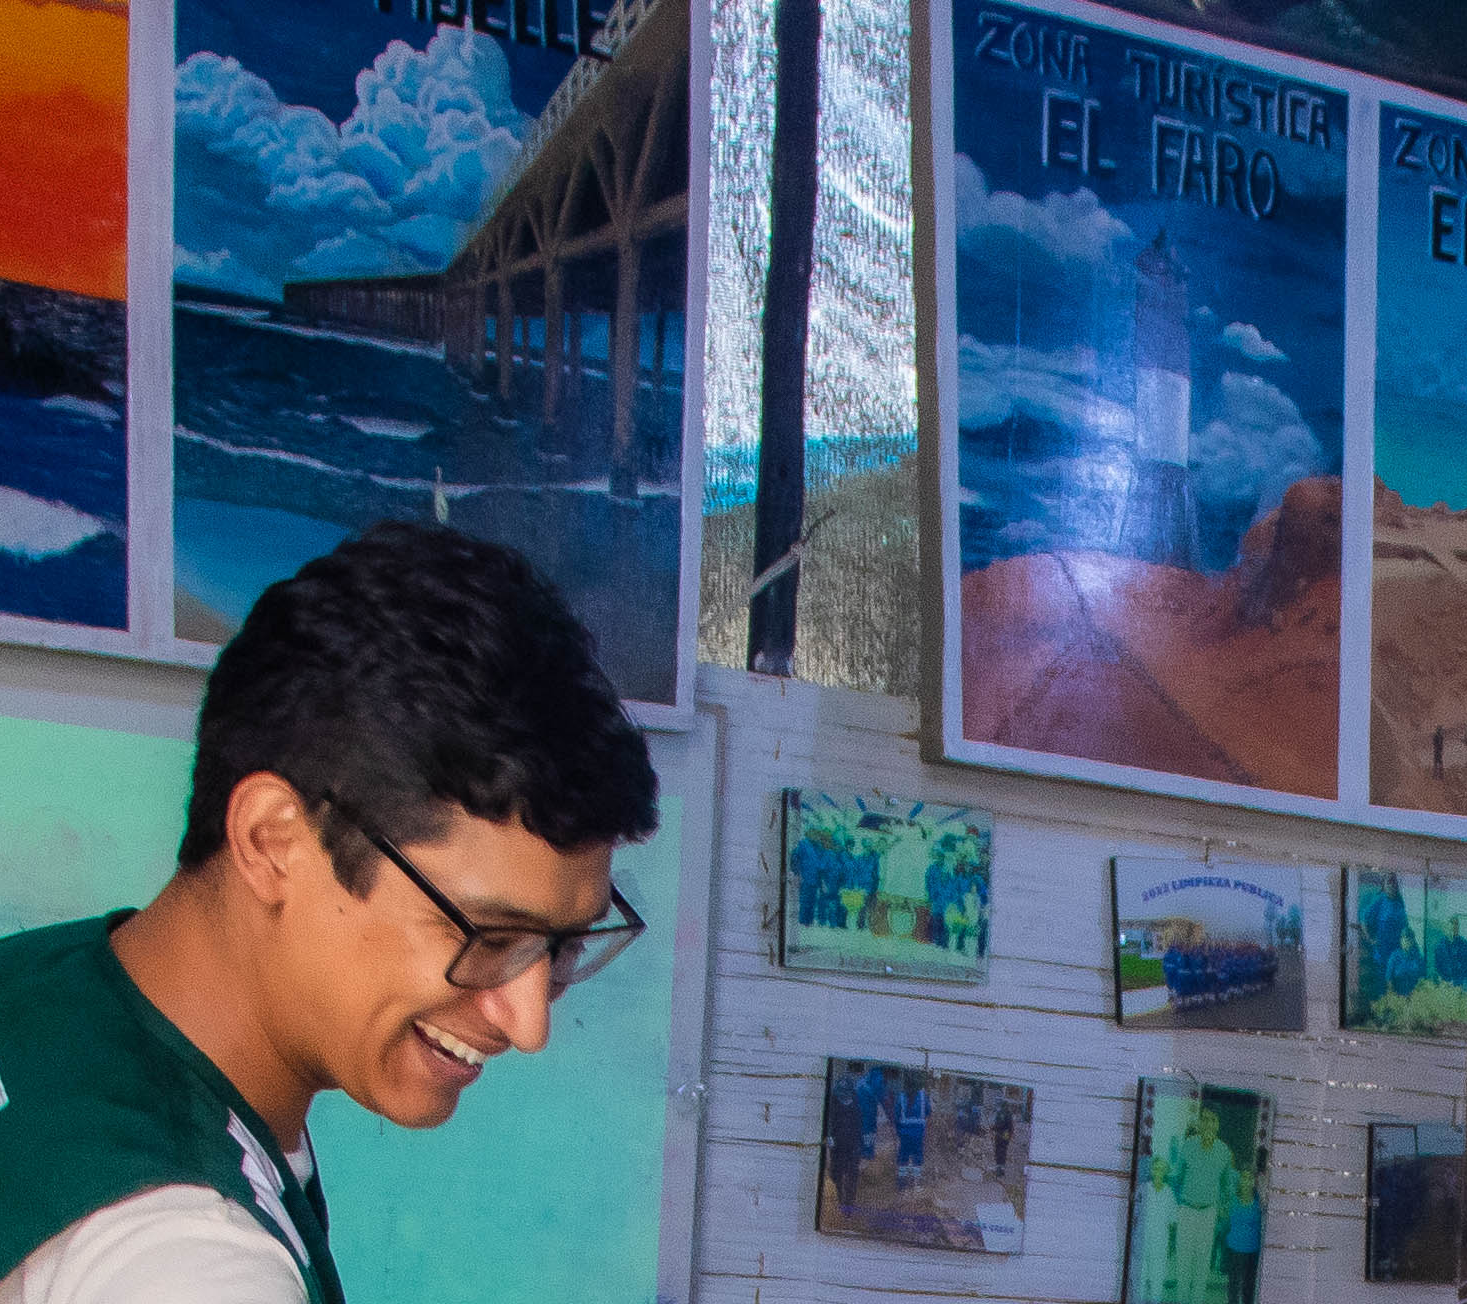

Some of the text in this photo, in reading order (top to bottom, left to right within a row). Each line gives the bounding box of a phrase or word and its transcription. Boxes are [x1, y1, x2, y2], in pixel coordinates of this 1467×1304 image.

[975, 10, 1089, 83] ZONA
[1042, 88, 1279, 221] EL FARO
